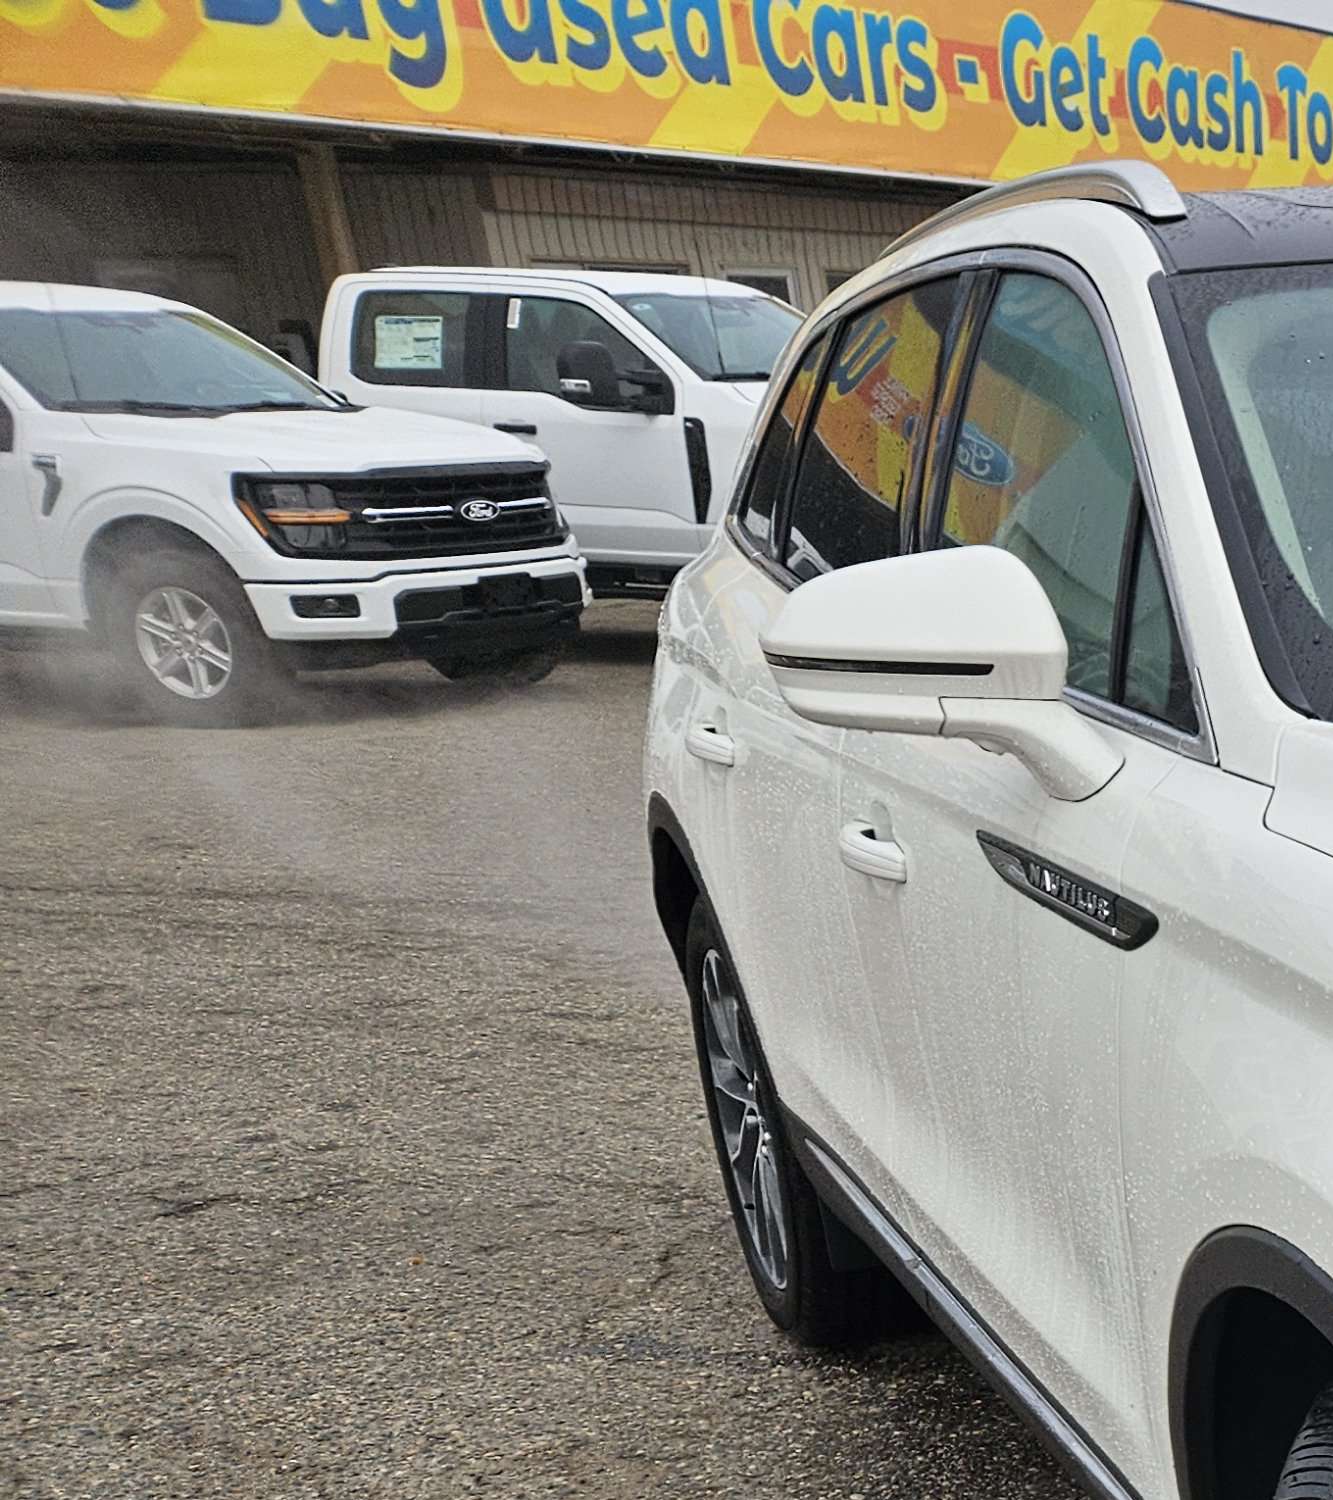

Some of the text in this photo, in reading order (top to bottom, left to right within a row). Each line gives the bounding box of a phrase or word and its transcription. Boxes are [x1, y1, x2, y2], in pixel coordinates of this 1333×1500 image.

[483, 0, 732, 87] used
[755, 0, 937, 113] Cars
[1002, 11, 1111, 136] Get
[1127, 35, 1263, 156] Cash
